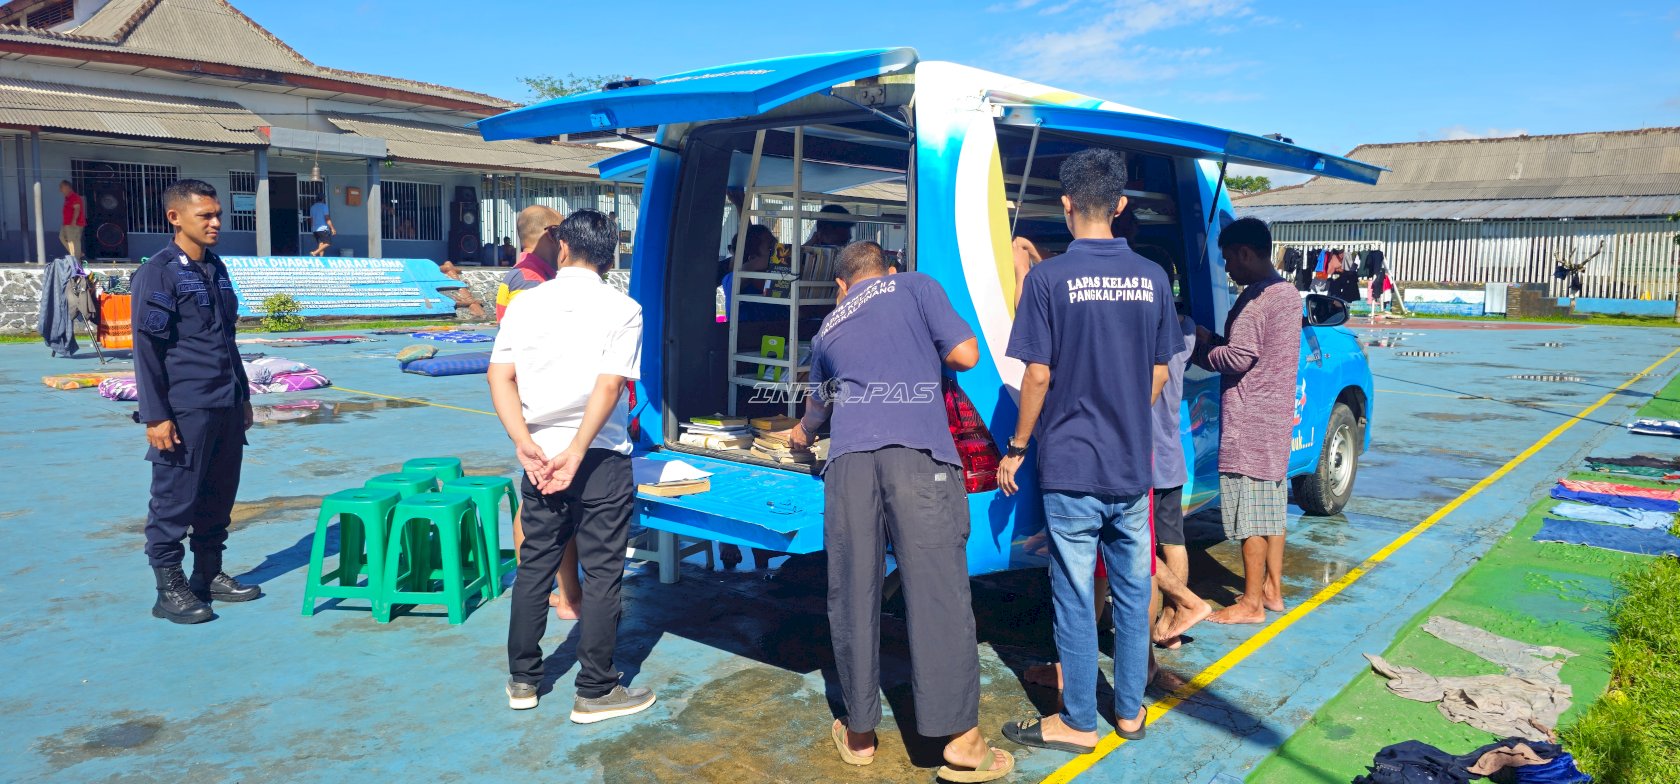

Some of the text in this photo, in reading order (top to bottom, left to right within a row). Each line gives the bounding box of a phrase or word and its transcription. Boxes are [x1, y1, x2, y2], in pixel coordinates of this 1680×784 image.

[223, 257, 268, 268] CATUR
[269, 257, 325, 268] DHARMA
[1067, 276, 1101, 291] LAPAS
[1102, 276, 1139, 289] KELAS
[1068, 289, 1154, 304] PANGKALPINANG
